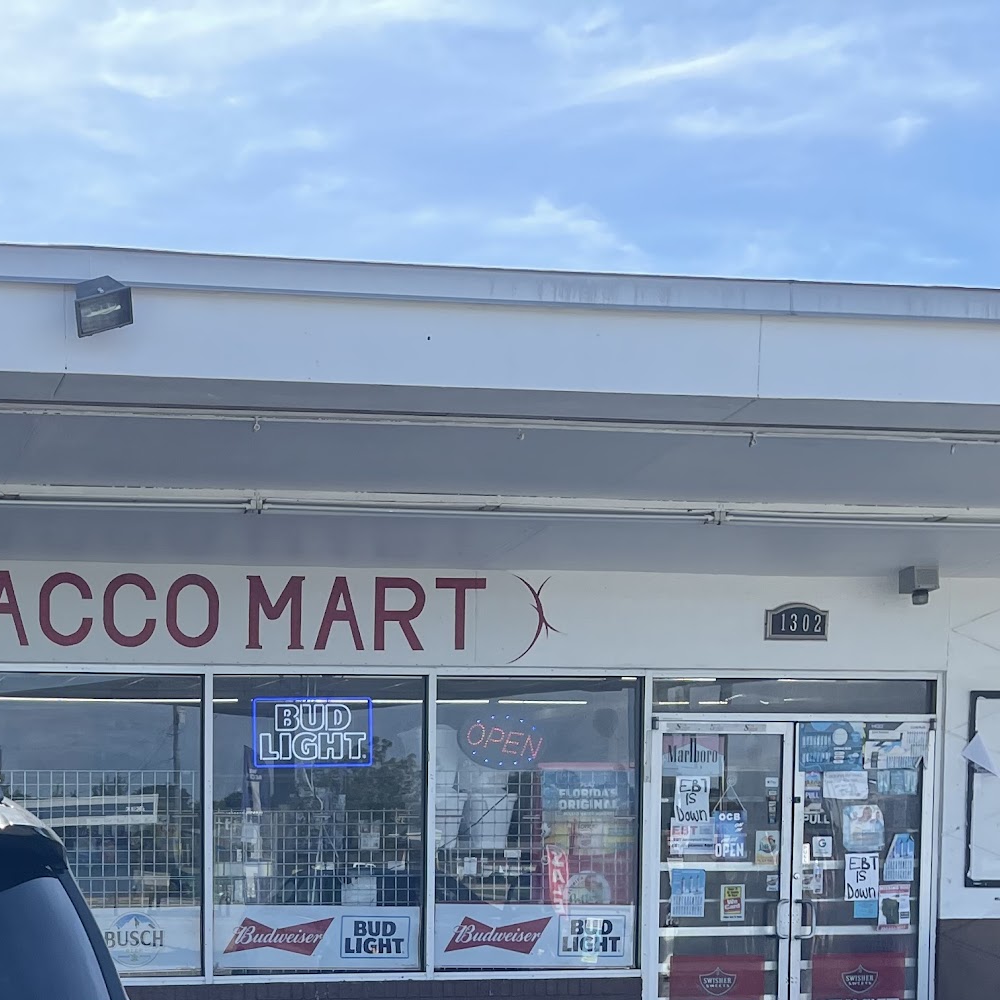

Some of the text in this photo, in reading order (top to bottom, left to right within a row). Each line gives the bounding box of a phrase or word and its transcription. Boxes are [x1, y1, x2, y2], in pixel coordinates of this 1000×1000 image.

[245, 575, 487, 651] MART
[781, 613, 822, 632] 1302
[275, 703, 351, 732] BUD
[466, 723, 543, 760] OPEN
[667, 737, 718, 763] Marlboro
[558, 788, 618, 798] FLORIDA'S
[679, 778, 708, 793] EBT
[558, 799, 618, 810] ORIGINAL
[686, 793, 697, 806] IS
[676, 807, 708, 822] Down
[719, 813, 741, 821] OCB
[803, 814, 831, 824] PULL
[715, 842, 745, 858] OPEN
[848, 856, 878, 870] EBT
[856, 871, 867, 884] IS
[846, 883, 876, 899] Down
[233, 925, 323, 945] Budweiser
[353, 921, 396, 937] BUD
[453, 924, 543, 944] Budweiser
[570, 919, 613, 935] BUD
[104, 930, 164, 948] BUSCH
